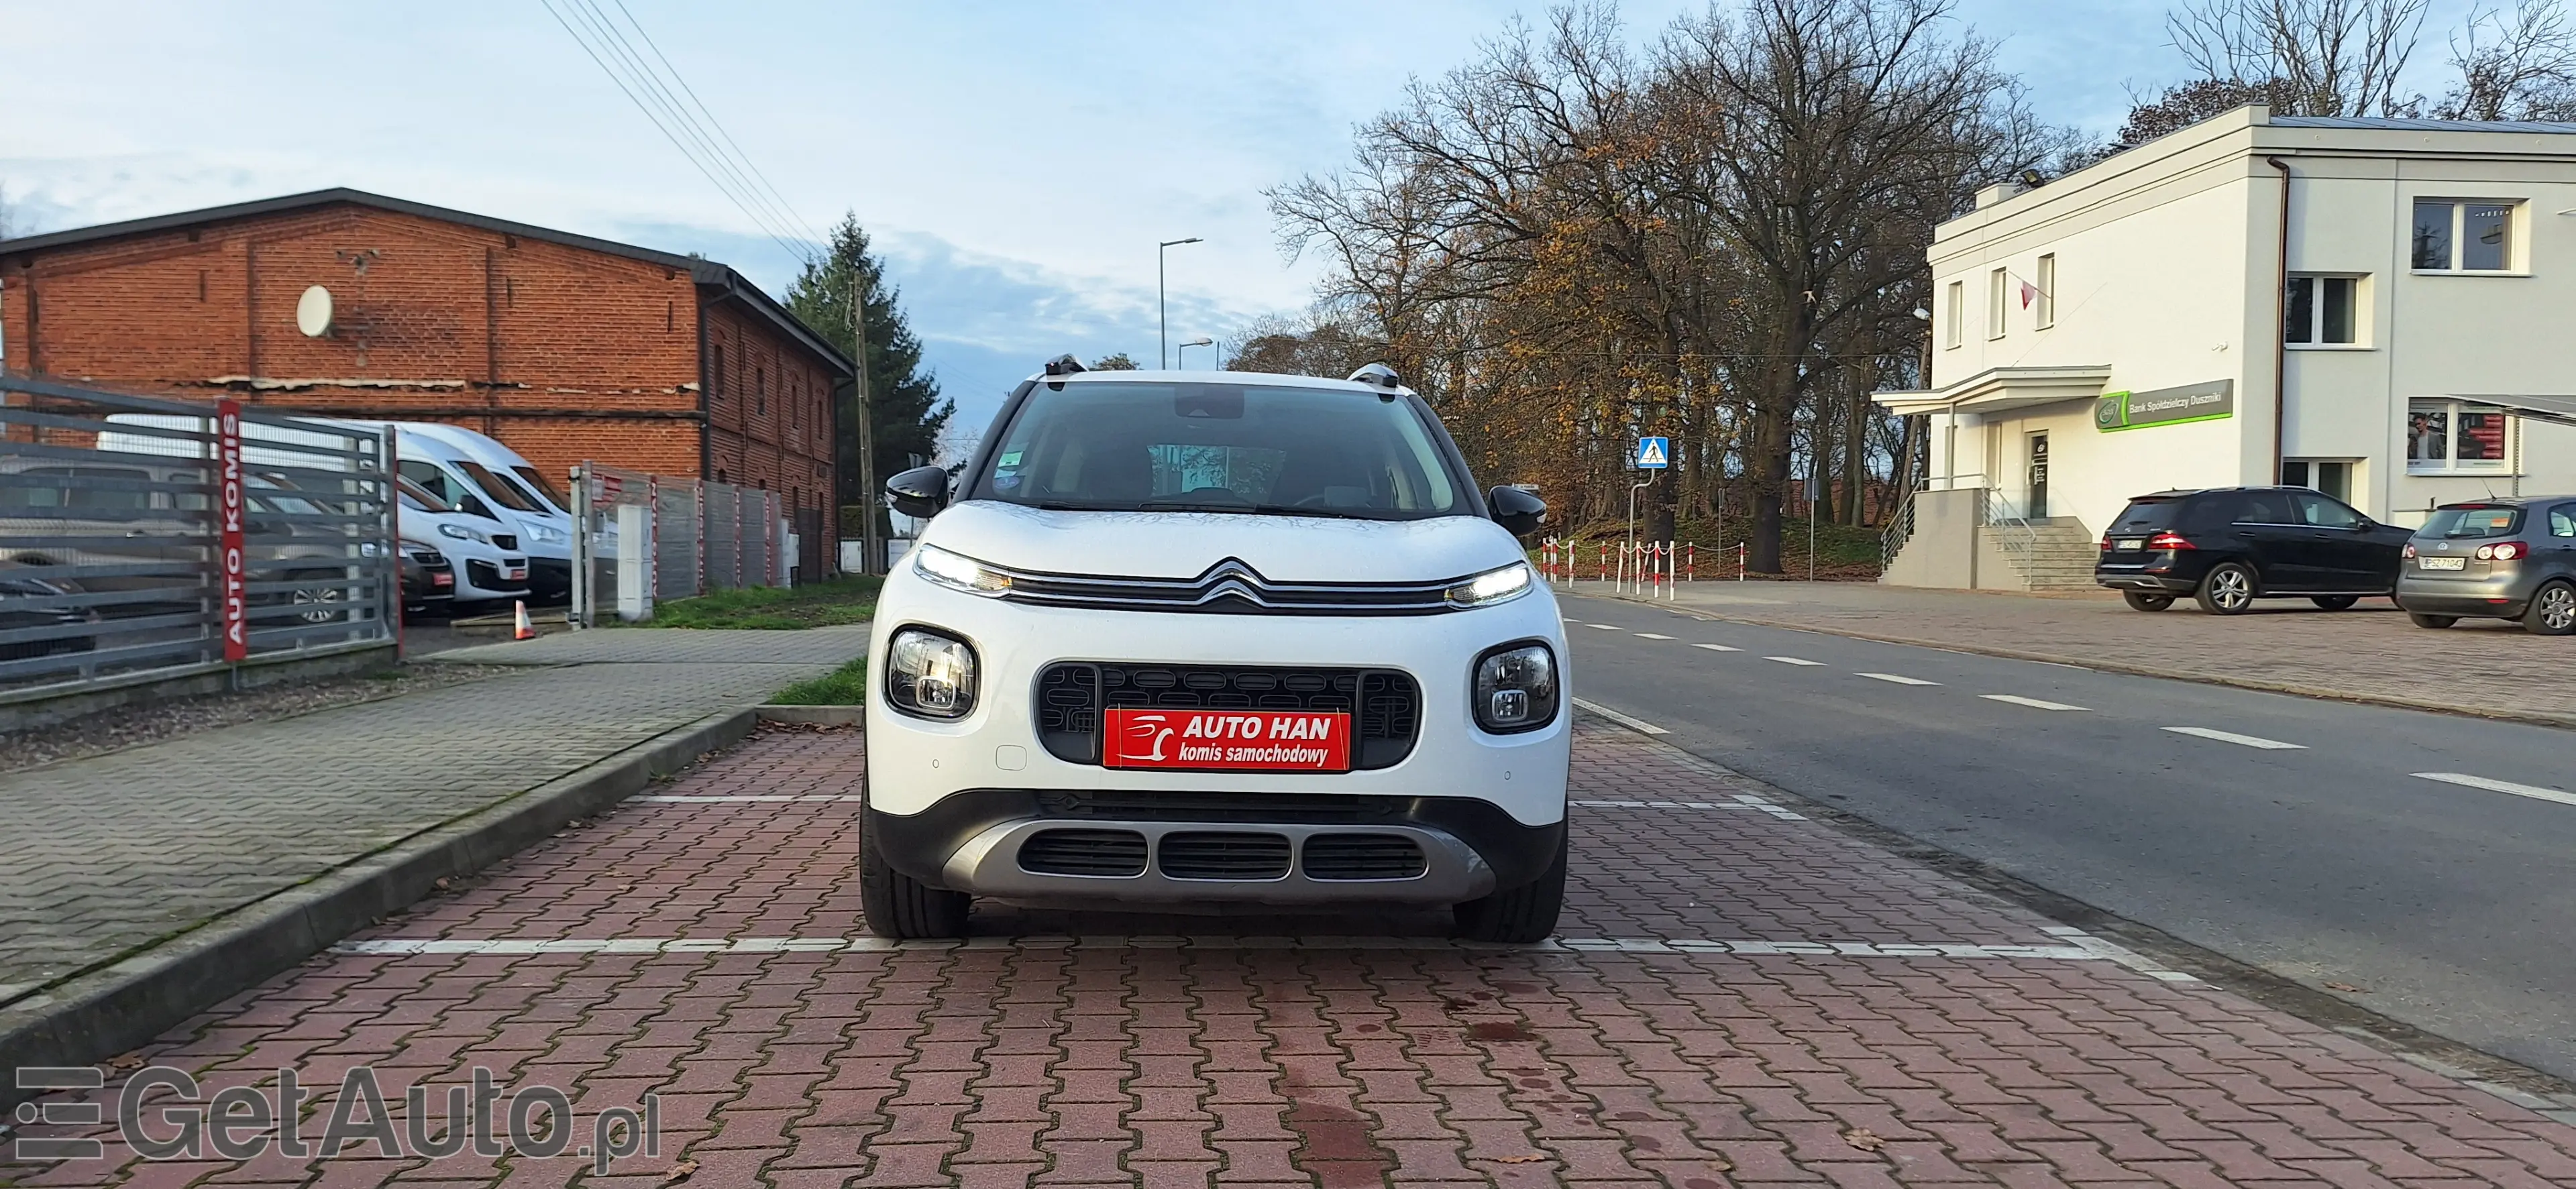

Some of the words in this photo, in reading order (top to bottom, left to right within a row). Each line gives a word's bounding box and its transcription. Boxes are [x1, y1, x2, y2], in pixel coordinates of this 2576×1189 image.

[2129, 404, 2147, 414] Bank
[2147, 398, 2189, 412] Spółdzielczy
[2190, 392, 2221, 405] Duszniki
[223, 413, 239, 532] KOMIS
[227, 547, 241, 644] AUTO
[1183, 716, 1262, 739] AUTO
[1269, 717, 1332, 740] HAN
[1179, 742, 1222, 761] komis
[1226, 743, 1329, 767] samochodowy
